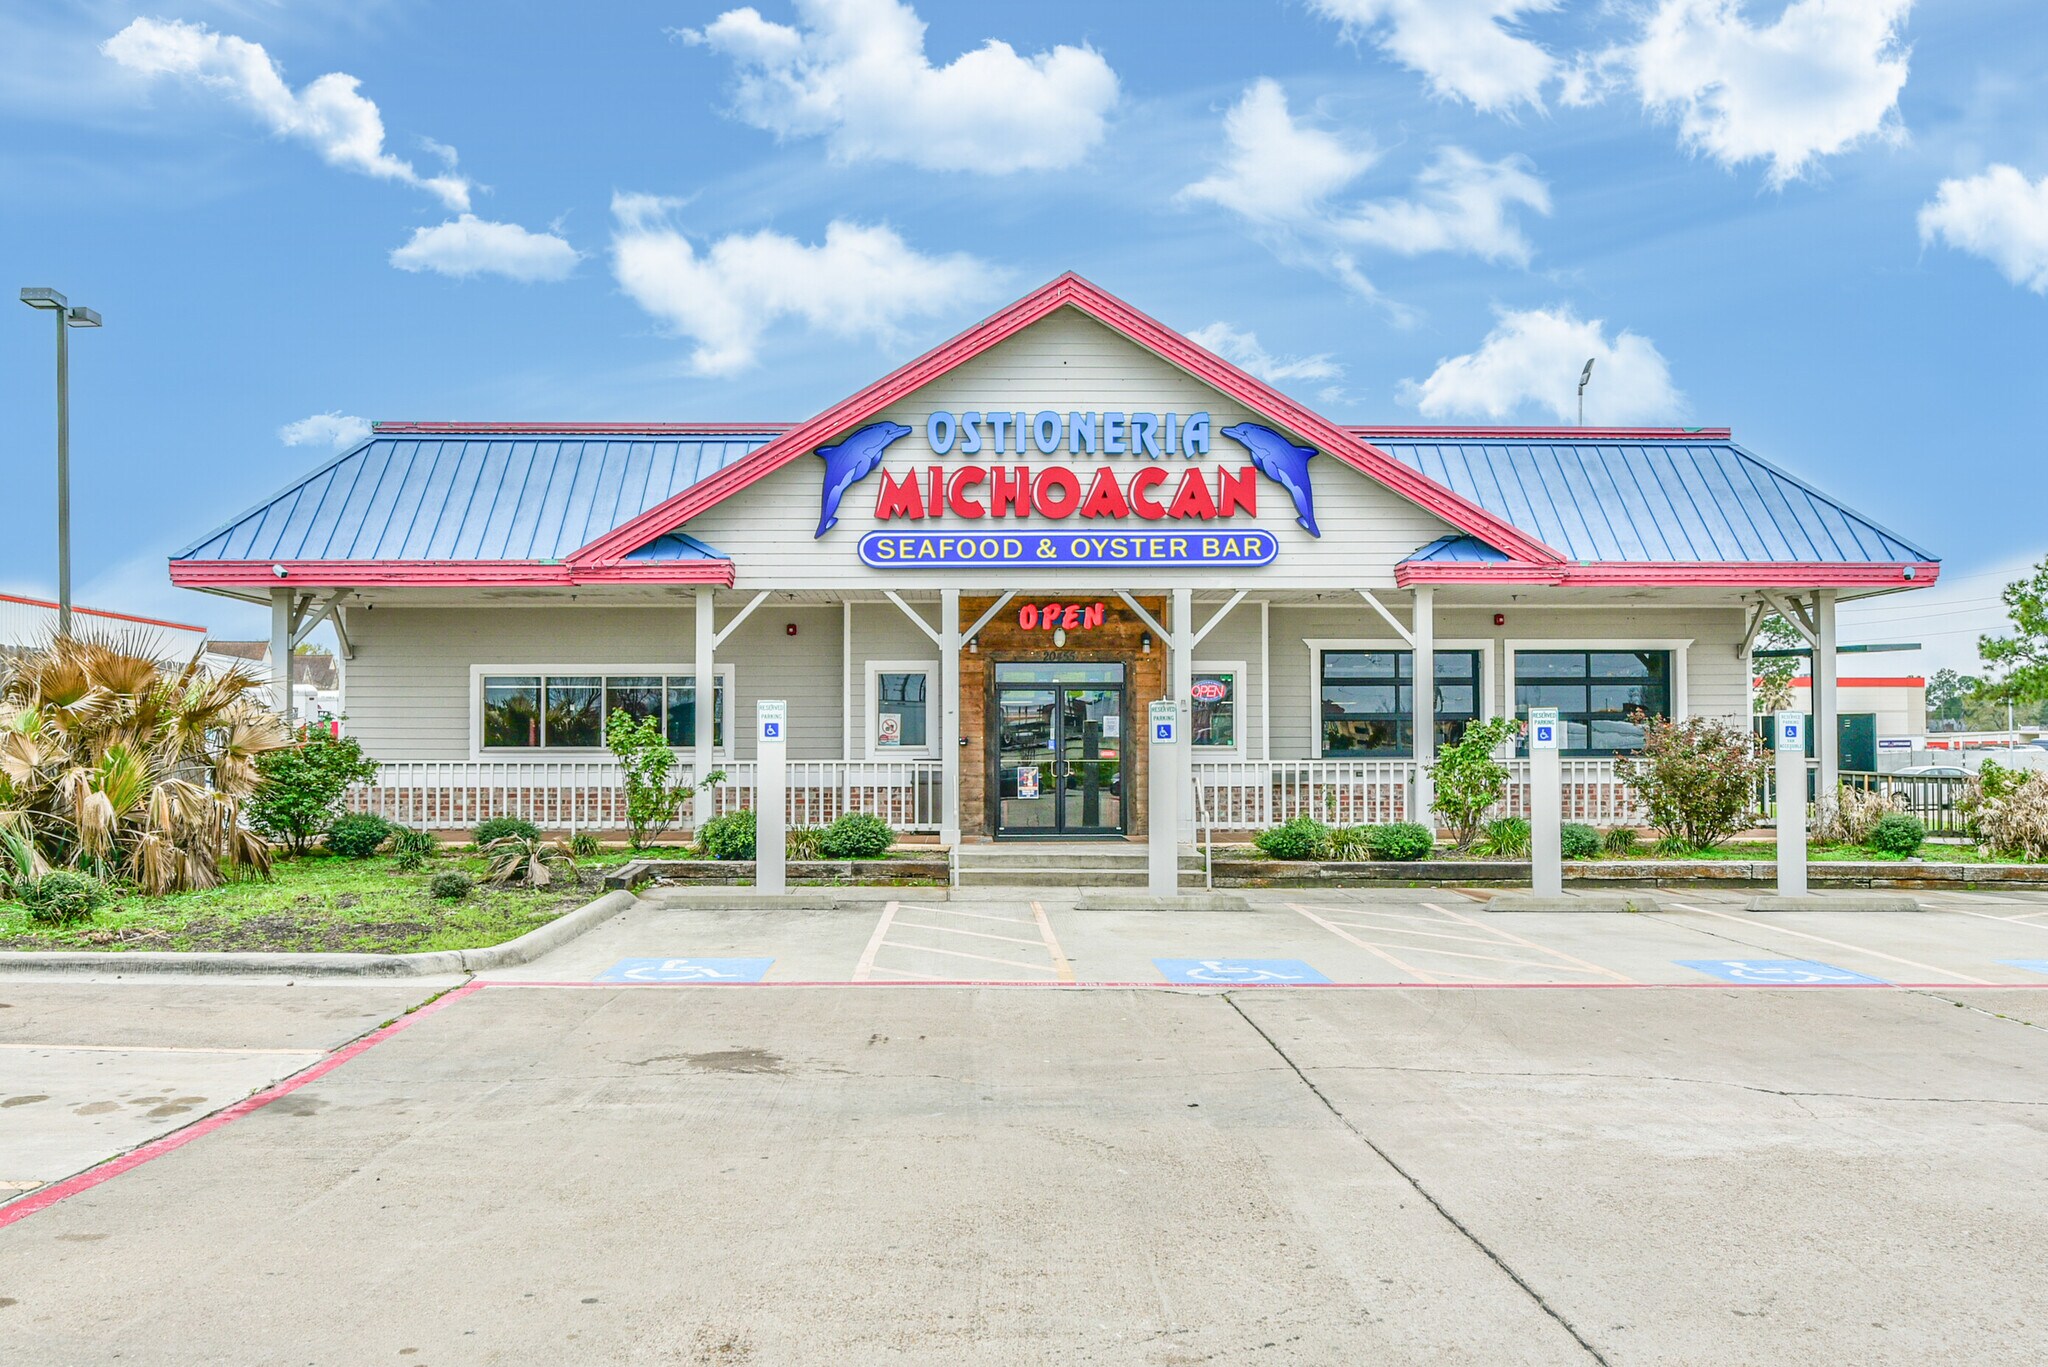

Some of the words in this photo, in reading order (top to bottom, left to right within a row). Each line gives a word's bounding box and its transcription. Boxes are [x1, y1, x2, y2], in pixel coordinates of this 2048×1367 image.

[927, 411, 1209, 459] OSTIONERIA
[874, 464, 1257, 520] MICHOACAN
[876, 539, 1023, 560] SEAFOOD
[1036, 539, 1058, 559] &
[1070, 538, 1188, 559] OYSTER
[1202, 538, 1262, 558] BAR
[1019, 602, 1105, 630] OPEN
[1191, 684, 1226, 698] OPEN
